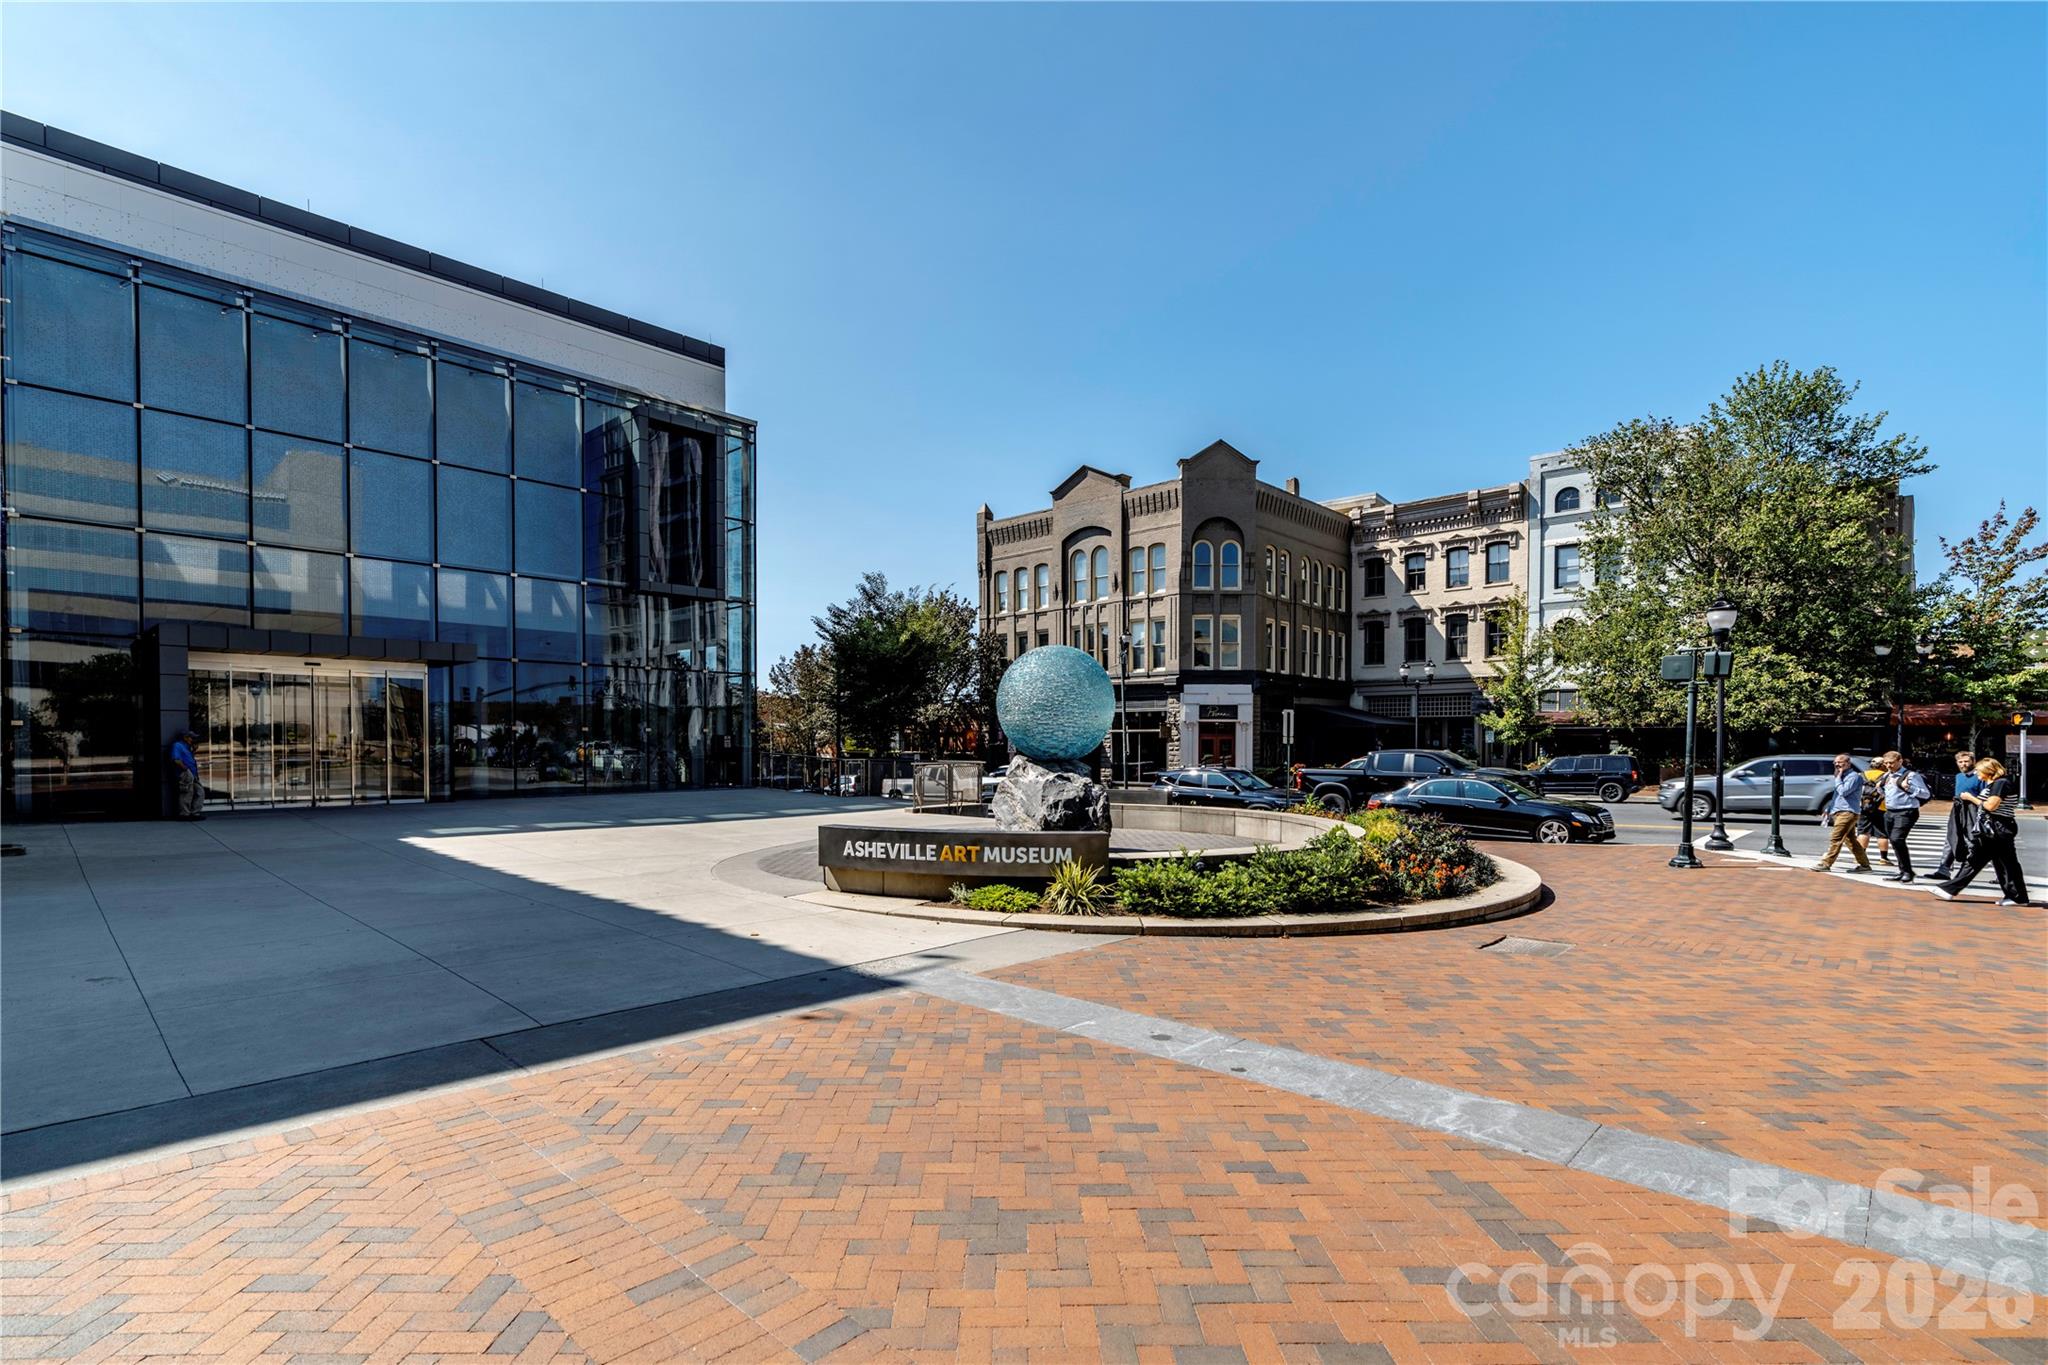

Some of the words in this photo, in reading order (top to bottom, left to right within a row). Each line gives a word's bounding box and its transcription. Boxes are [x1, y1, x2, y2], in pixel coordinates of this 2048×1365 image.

[843, 840, 937, 861] ASHEVILLE
[940, 845, 980, 863] ART
[983, 846, 1072, 864] MUSEUM
